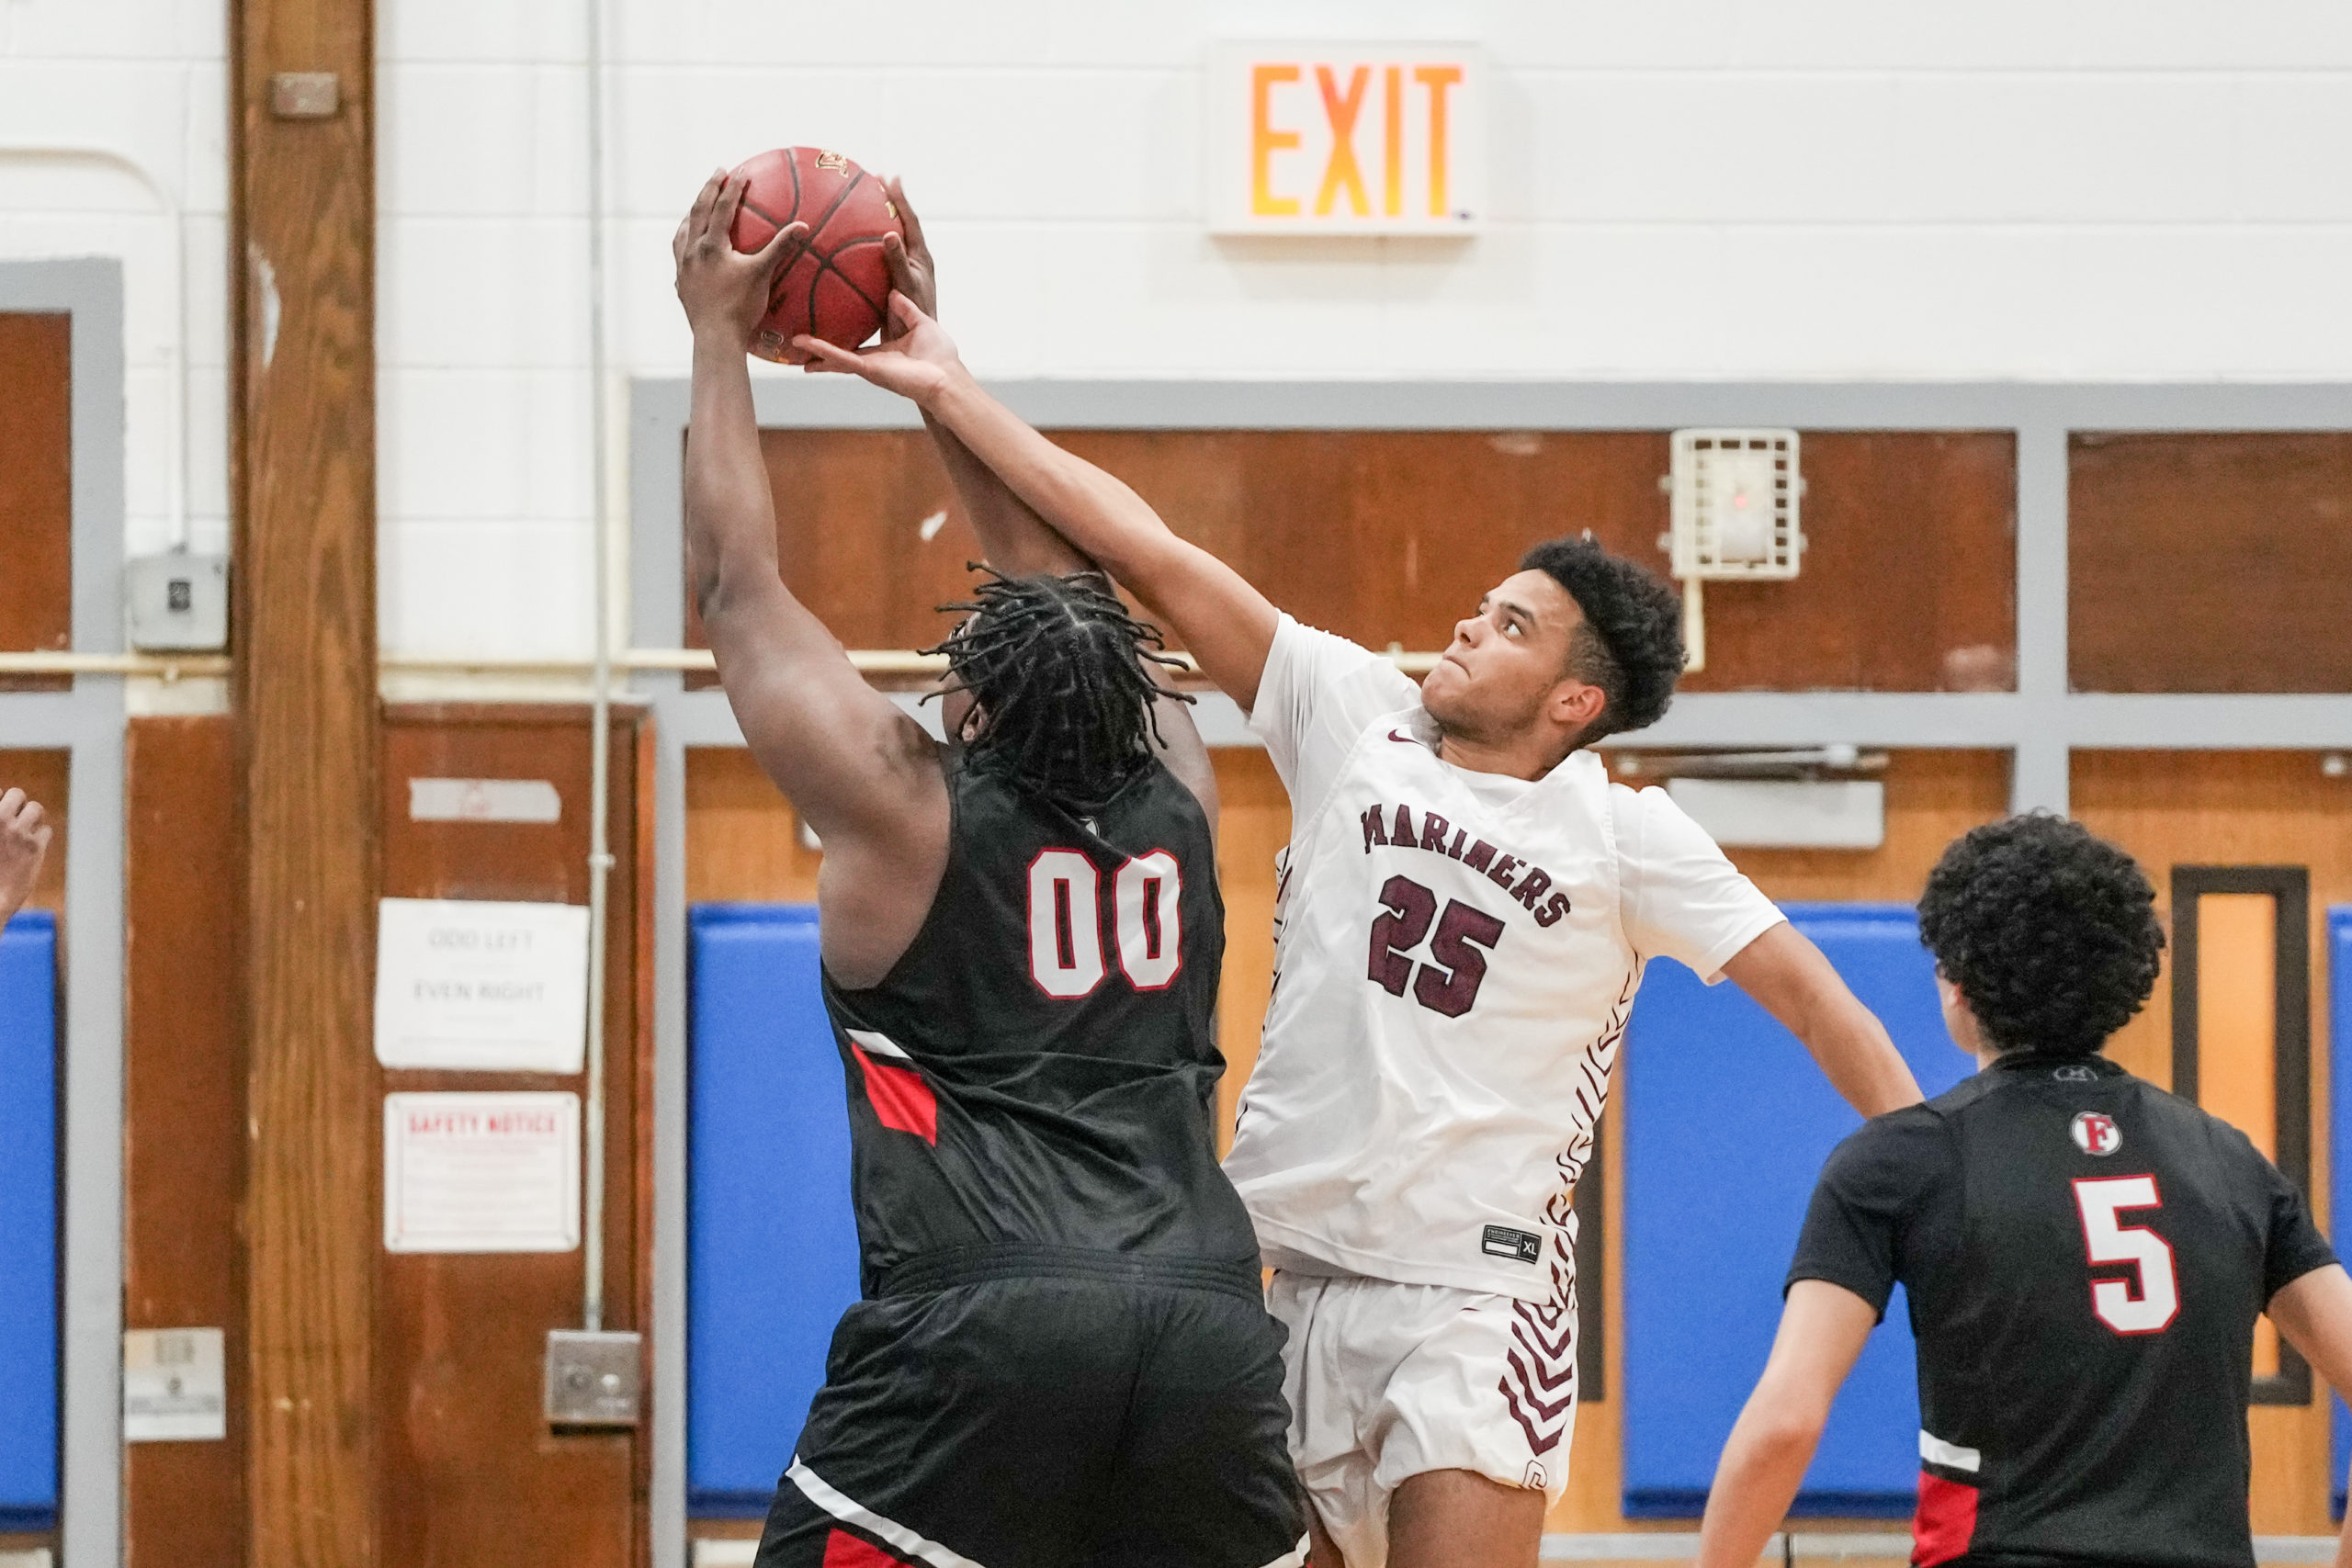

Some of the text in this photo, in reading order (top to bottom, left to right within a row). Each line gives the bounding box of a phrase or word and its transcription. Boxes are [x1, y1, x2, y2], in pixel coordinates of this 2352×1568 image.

[1250, 63, 1464, 218] EXIT
[1360, 803, 1572, 928] MARINERS
[427, 927, 535, 952] ODD LEFT
[1026, 846, 1183, 1000] 00
[1367, 874, 1506, 1019] 25
[413, 978, 546, 1003] EVEN RIGHT
[409, 1112, 557, 1135] SAFETY NOTICE
[2081, 1117, 2111, 1152] F
[1522, 1240, 1537, 1256] XL
[2071, 1173, 2181, 1336] 5
